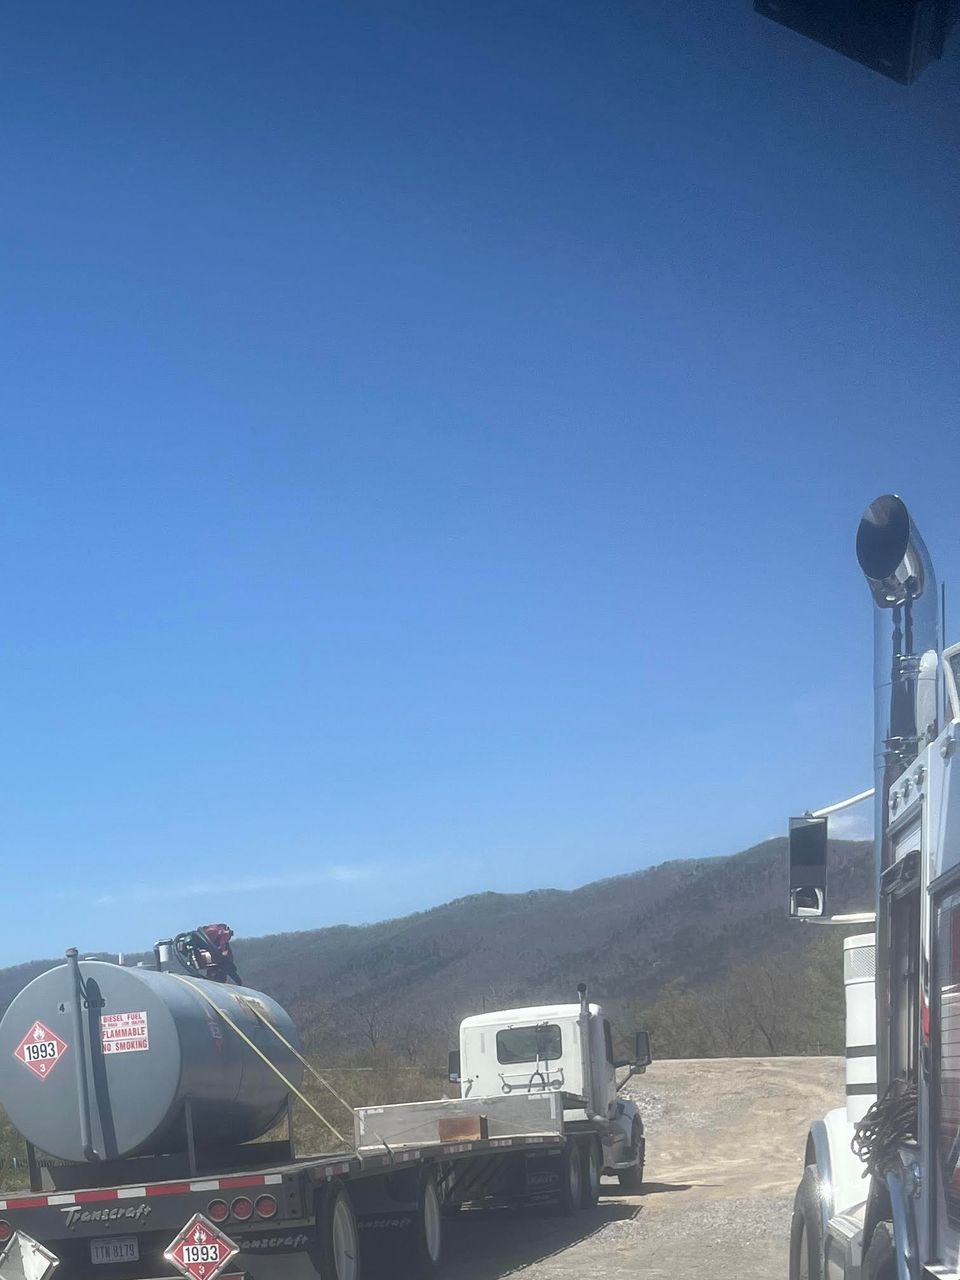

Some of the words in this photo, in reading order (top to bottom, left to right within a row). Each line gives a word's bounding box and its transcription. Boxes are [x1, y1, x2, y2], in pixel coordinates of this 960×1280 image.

[103, 1014, 124, 1023] DIESEL
[127, 1013, 142, 1021] FUEL
[102, 1027, 146, 1039] FLAMMABLE
[26, 1042, 56, 1060] 1993
[102, 1042, 112, 1052] NO
[115, 1039, 147, 1051] SMOKING
[39, 1064, 46, 1072] 3
[60, 1204, 152, 1228] Transcraft
[184, 1245, 219, 1261] 1993
[198, 1265, 205, 1275] 3
